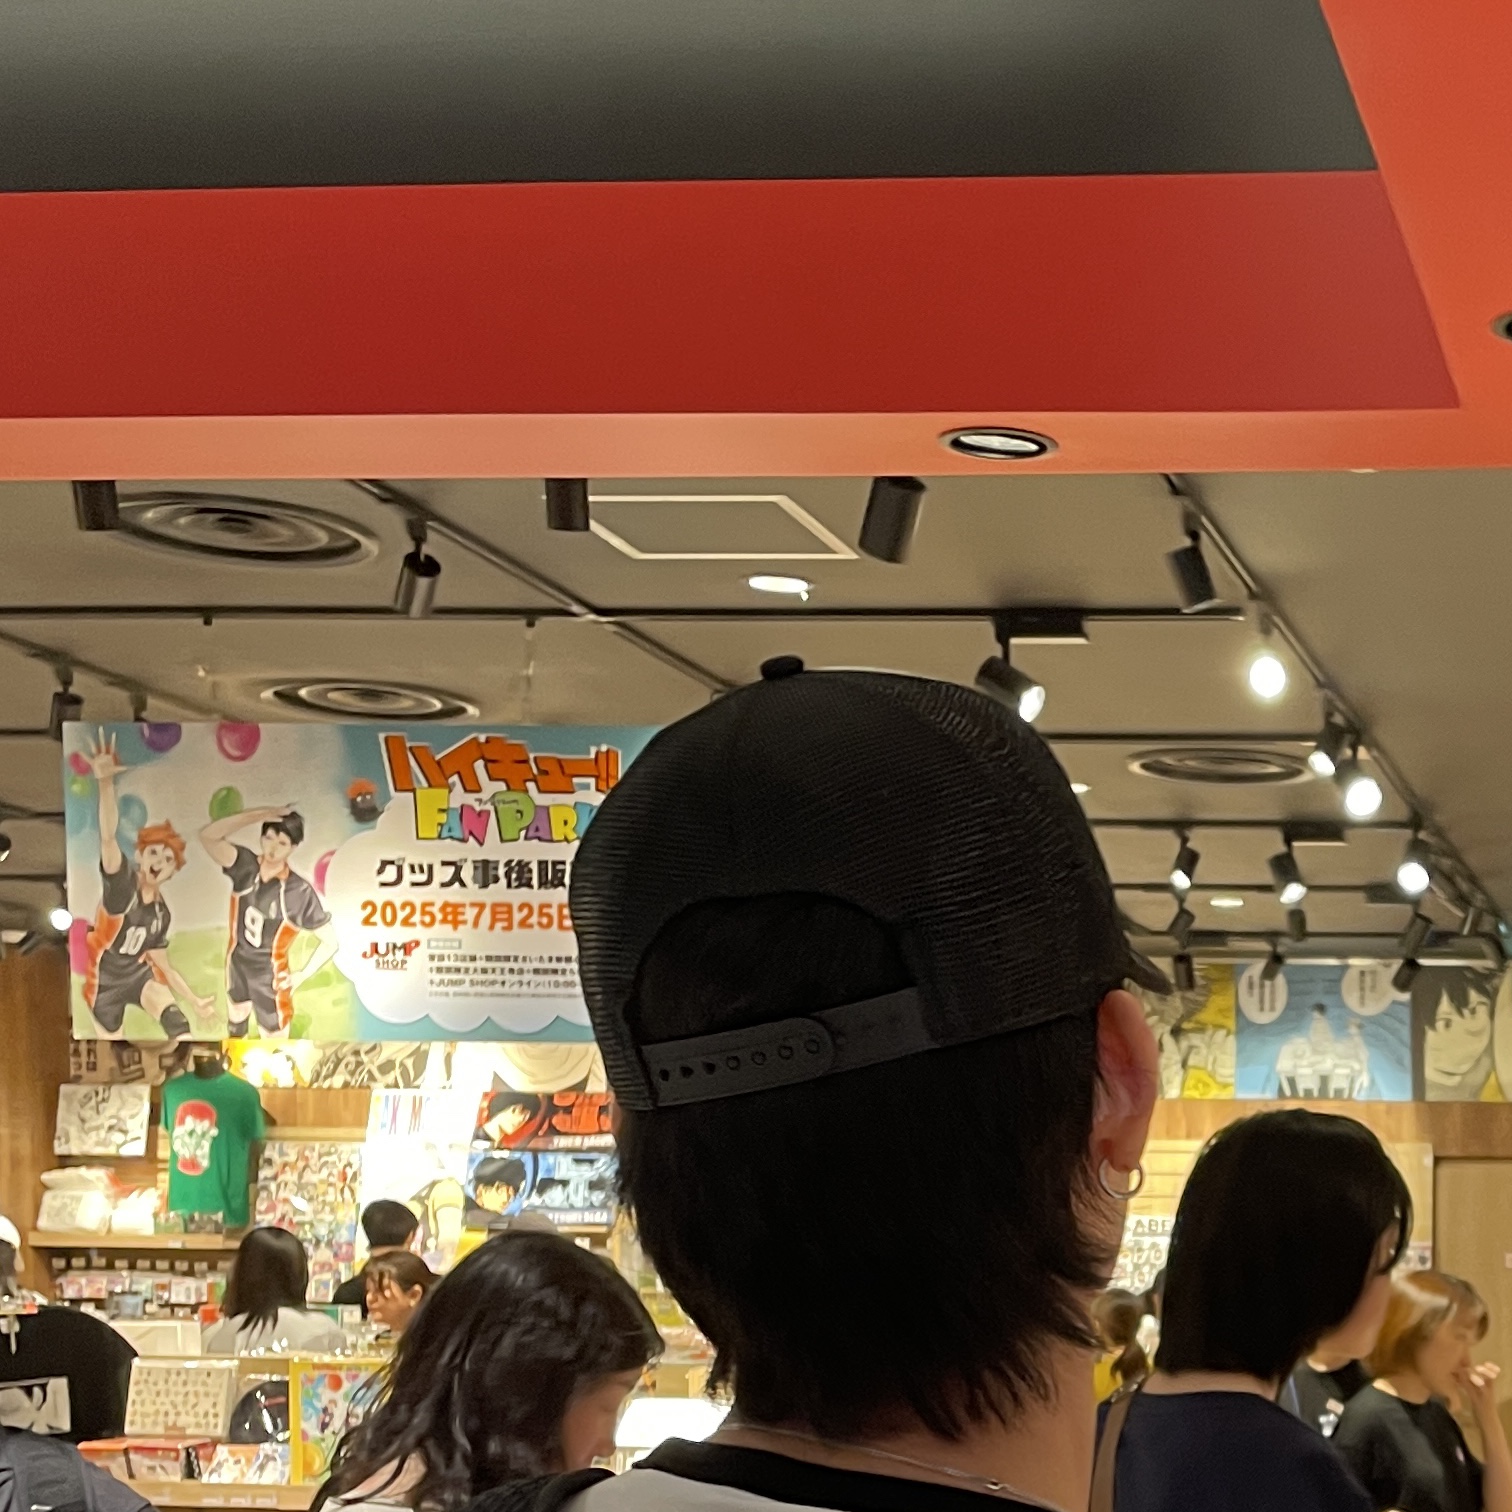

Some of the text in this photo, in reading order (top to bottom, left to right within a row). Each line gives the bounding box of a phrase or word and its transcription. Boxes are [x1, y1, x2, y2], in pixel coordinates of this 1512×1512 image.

[414, 786, 491, 847] FAN
[376, 856, 571, 891] グッズ事後販
[362, 938, 422, 960] JUMP
[375, 958, 408, 970] SHOP
